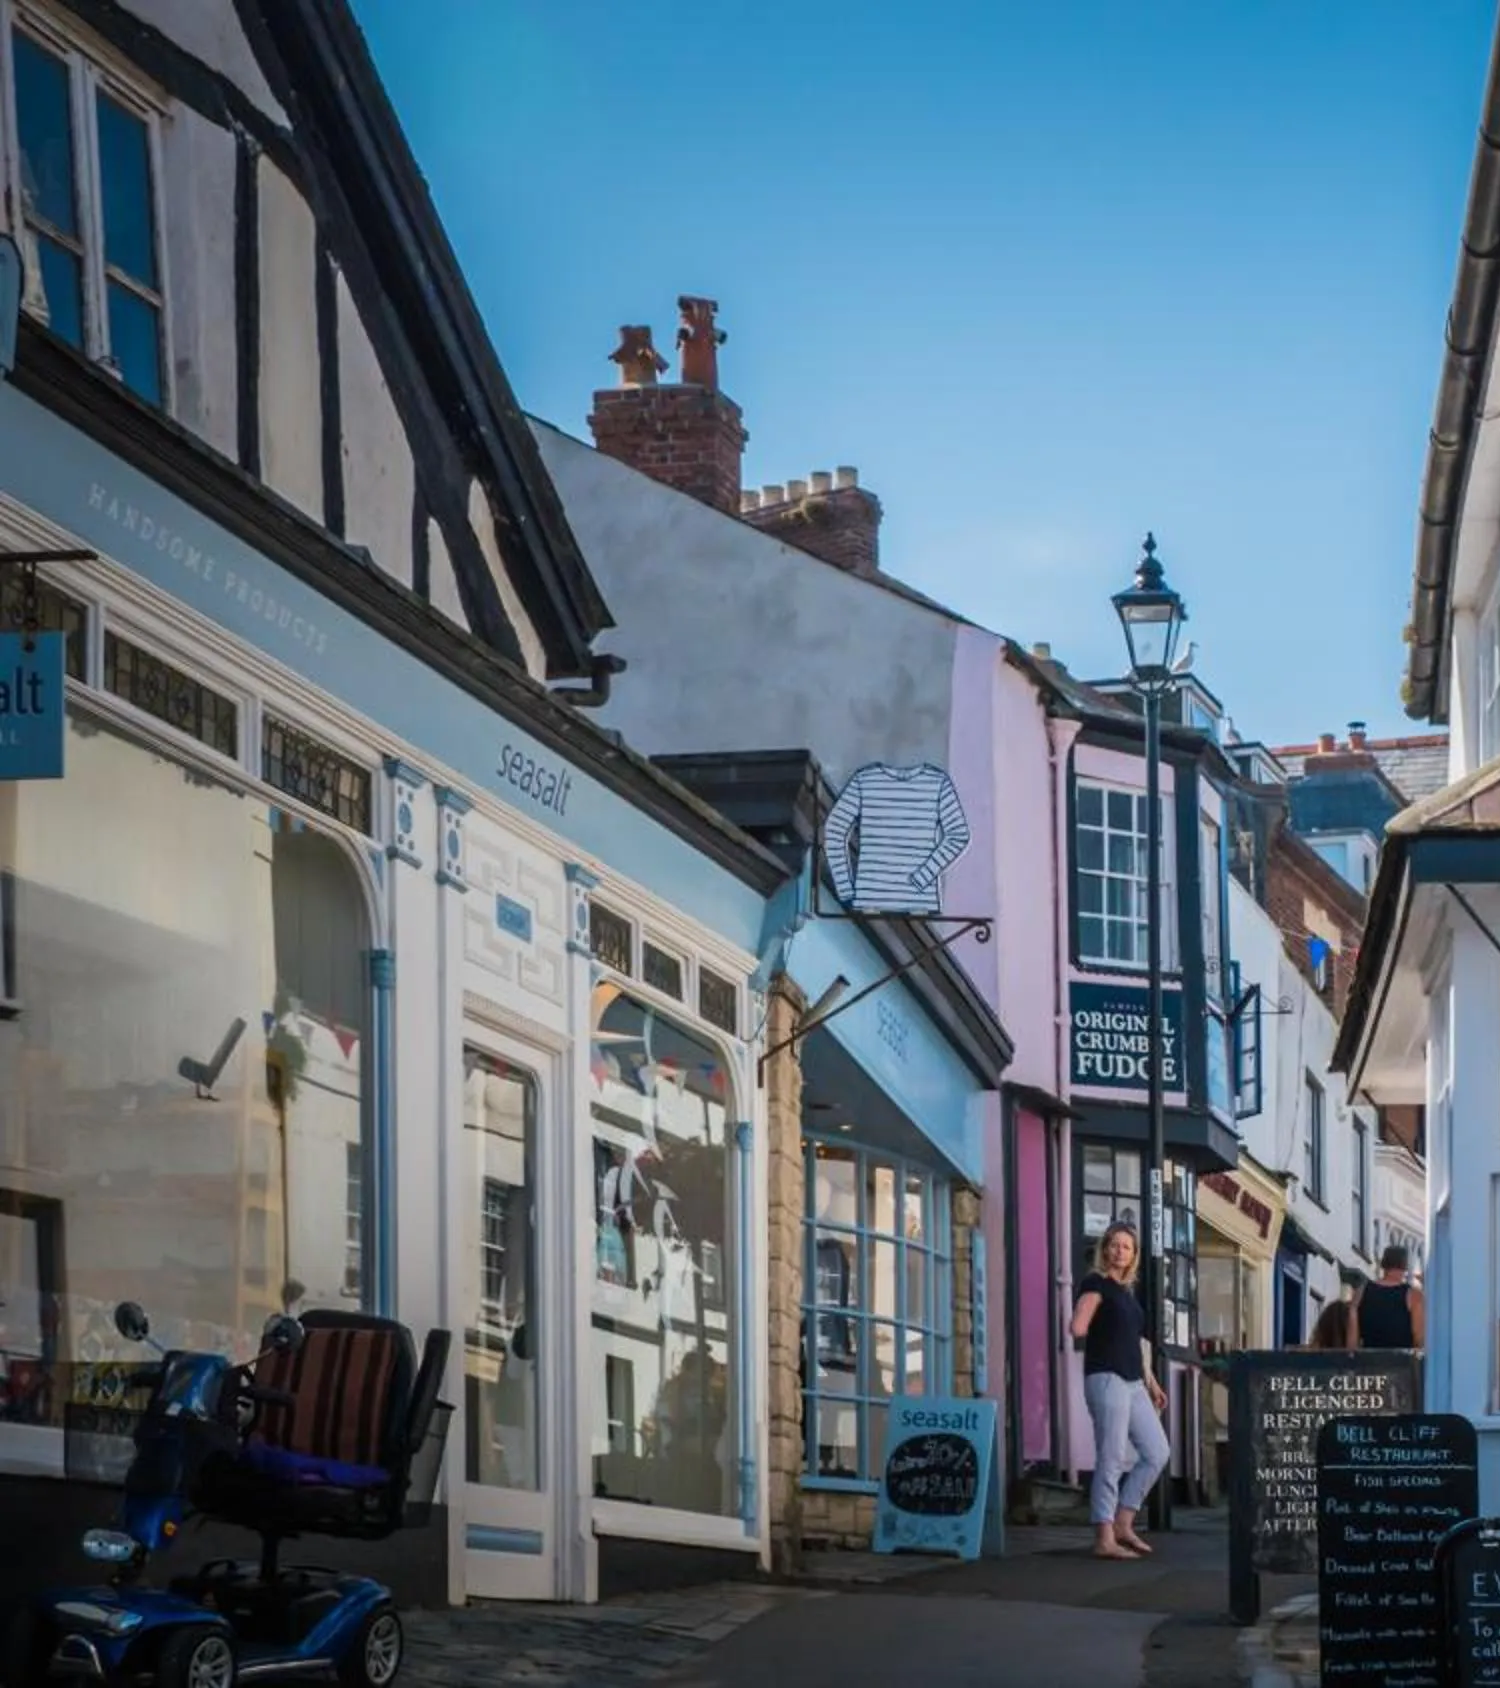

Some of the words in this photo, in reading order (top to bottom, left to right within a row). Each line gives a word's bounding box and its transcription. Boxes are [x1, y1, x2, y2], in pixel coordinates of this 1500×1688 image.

[88, 482, 216, 582] HANDSOME
[224, 569, 328, 655] PRODUCTS
[496, 743, 571, 816] seasalt
[1075, 1010, 1175, 1035] ORIGINL
[1075, 1031, 1175, 1055] CRUMBY
[1270, 1375, 1322, 1391] BELL
[1329, 1375, 1387, 1391] CLIFF
[1281, 1394, 1384, 1409] LICENCED
[901, 1408, 980, 1431] seasalt
[1337, 1423, 1377, 1443] BELL
[1388, 1424, 1441, 1443] CLIFF
[1274, 1500, 1317, 1514] LIGH
[1263, 1519, 1318, 1532] AFTER
[1468, 1616, 1494, 1637] To
